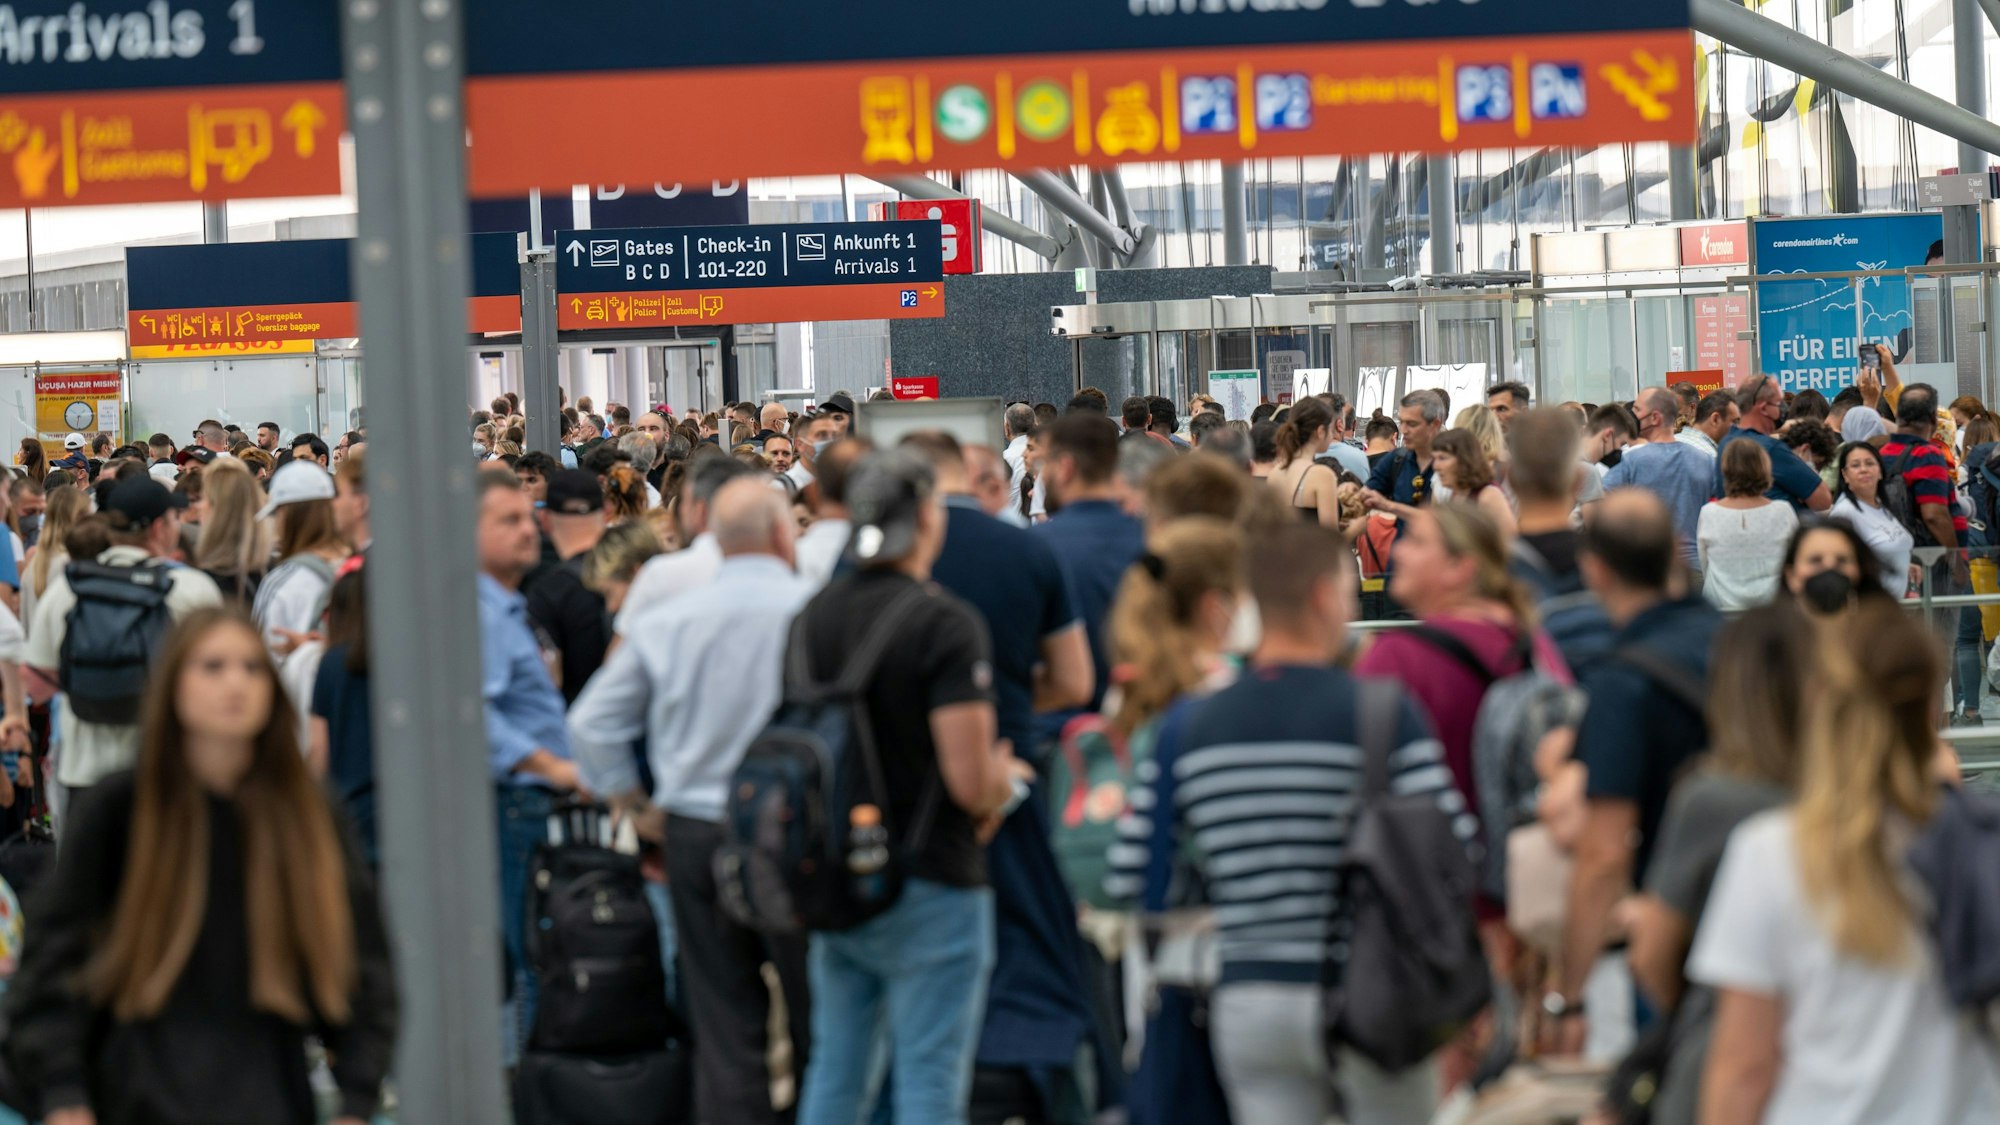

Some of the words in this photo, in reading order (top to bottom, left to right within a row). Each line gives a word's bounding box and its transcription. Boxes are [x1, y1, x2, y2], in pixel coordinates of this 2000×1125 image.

[227, 0, 265, 55] 1
[624, 240, 674, 256] Gates
[697, 236, 771, 254] Check-in
[833, 233, 900, 251] Ankunft
[906, 232, 917, 249] 1
[698, 260, 767, 278] 101-220
[834, 257, 899, 275] Arrivals
[907, 256, 917, 273] 1
[625, 264, 637, 281] B
[642, 263, 653, 280] C
[659, 263, 670, 279] D
[633, 299, 661, 307] Polizei
[667, 298, 682, 306] Zoll
[633, 308, 657, 317] Police
[667, 307, 699, 316] Customs
[166, 314, 178, 322] WC
[191, 316, 202, 324] WC
[255, 312, 303, 322] Sperrgepäck
[256, 323, 288, 332] Oversize
[289, 322, 321, 332] baggage
[1779, 334, 1825, 361] FÜR
[67, 381, 92, 389] HAZIR
